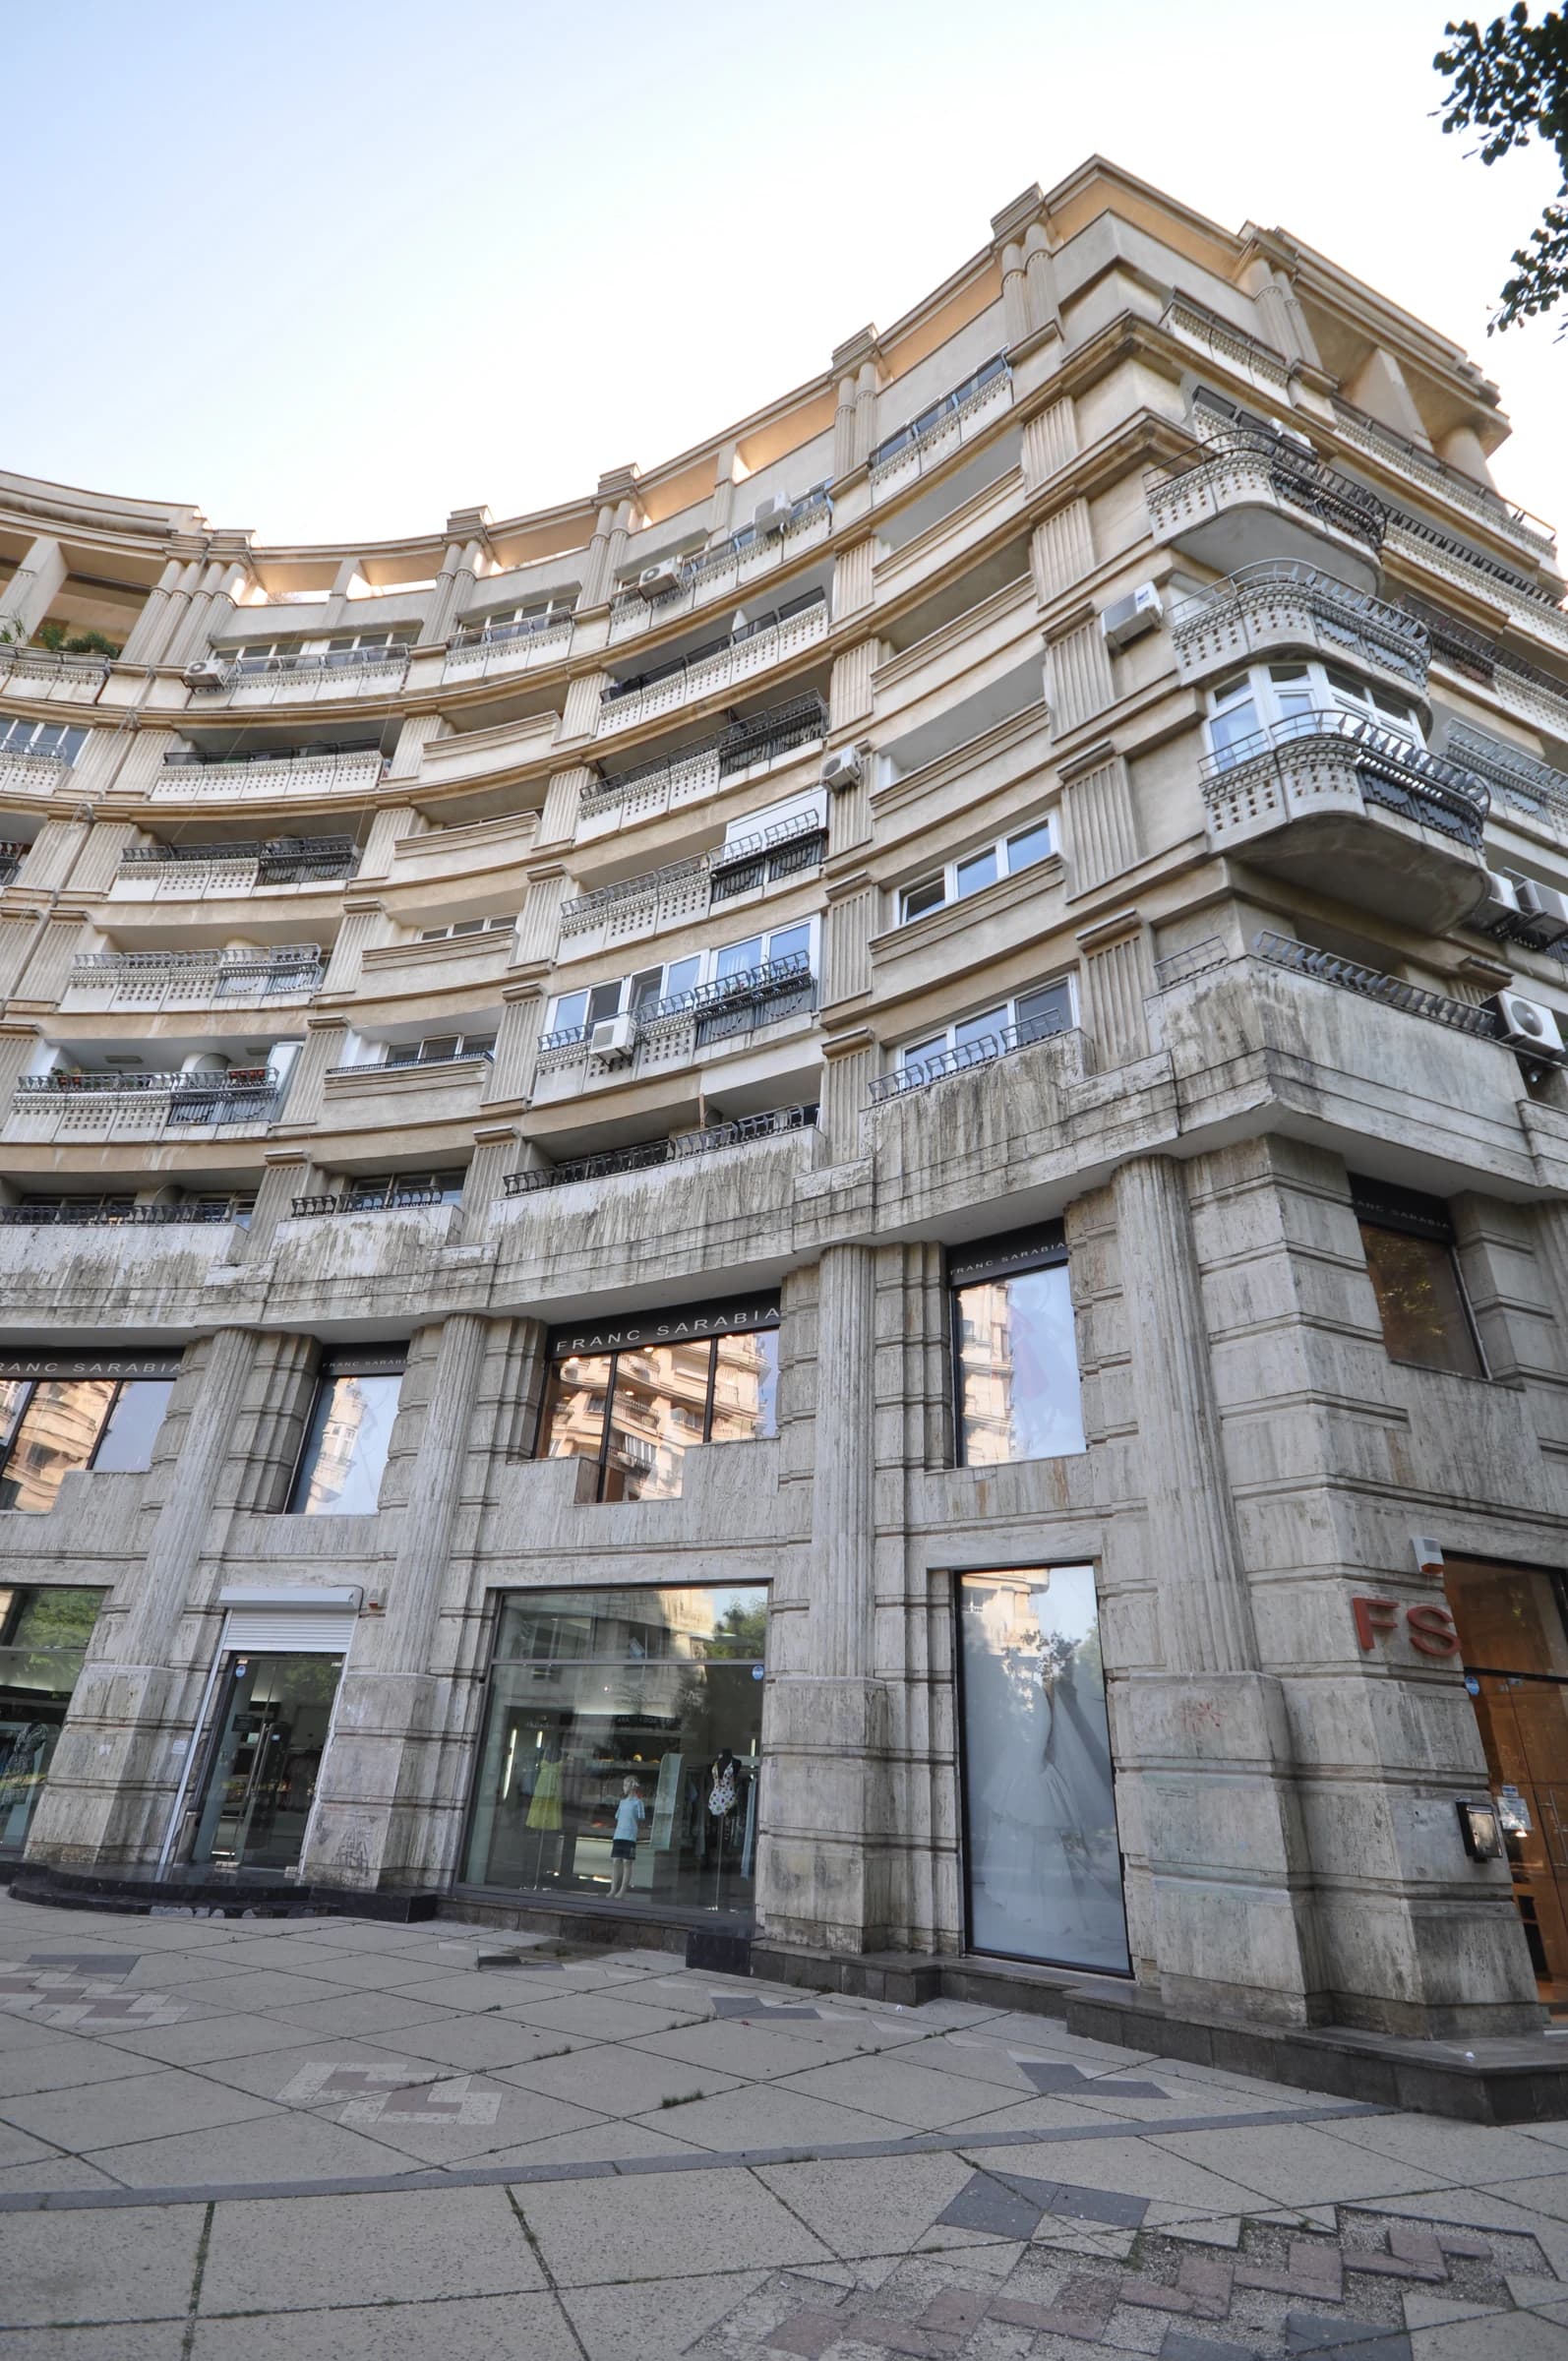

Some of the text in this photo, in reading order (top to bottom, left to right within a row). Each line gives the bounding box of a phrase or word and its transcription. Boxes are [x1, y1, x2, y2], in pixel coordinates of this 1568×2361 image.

[949, 1241, 1065, 1276] FRANC SARABIA
[556, 1306, 780, 1352] FRANC SARABIA
[73, 1362, 183, 1373] SARABIA
[1352, 1597, 1463, 1657] FS
